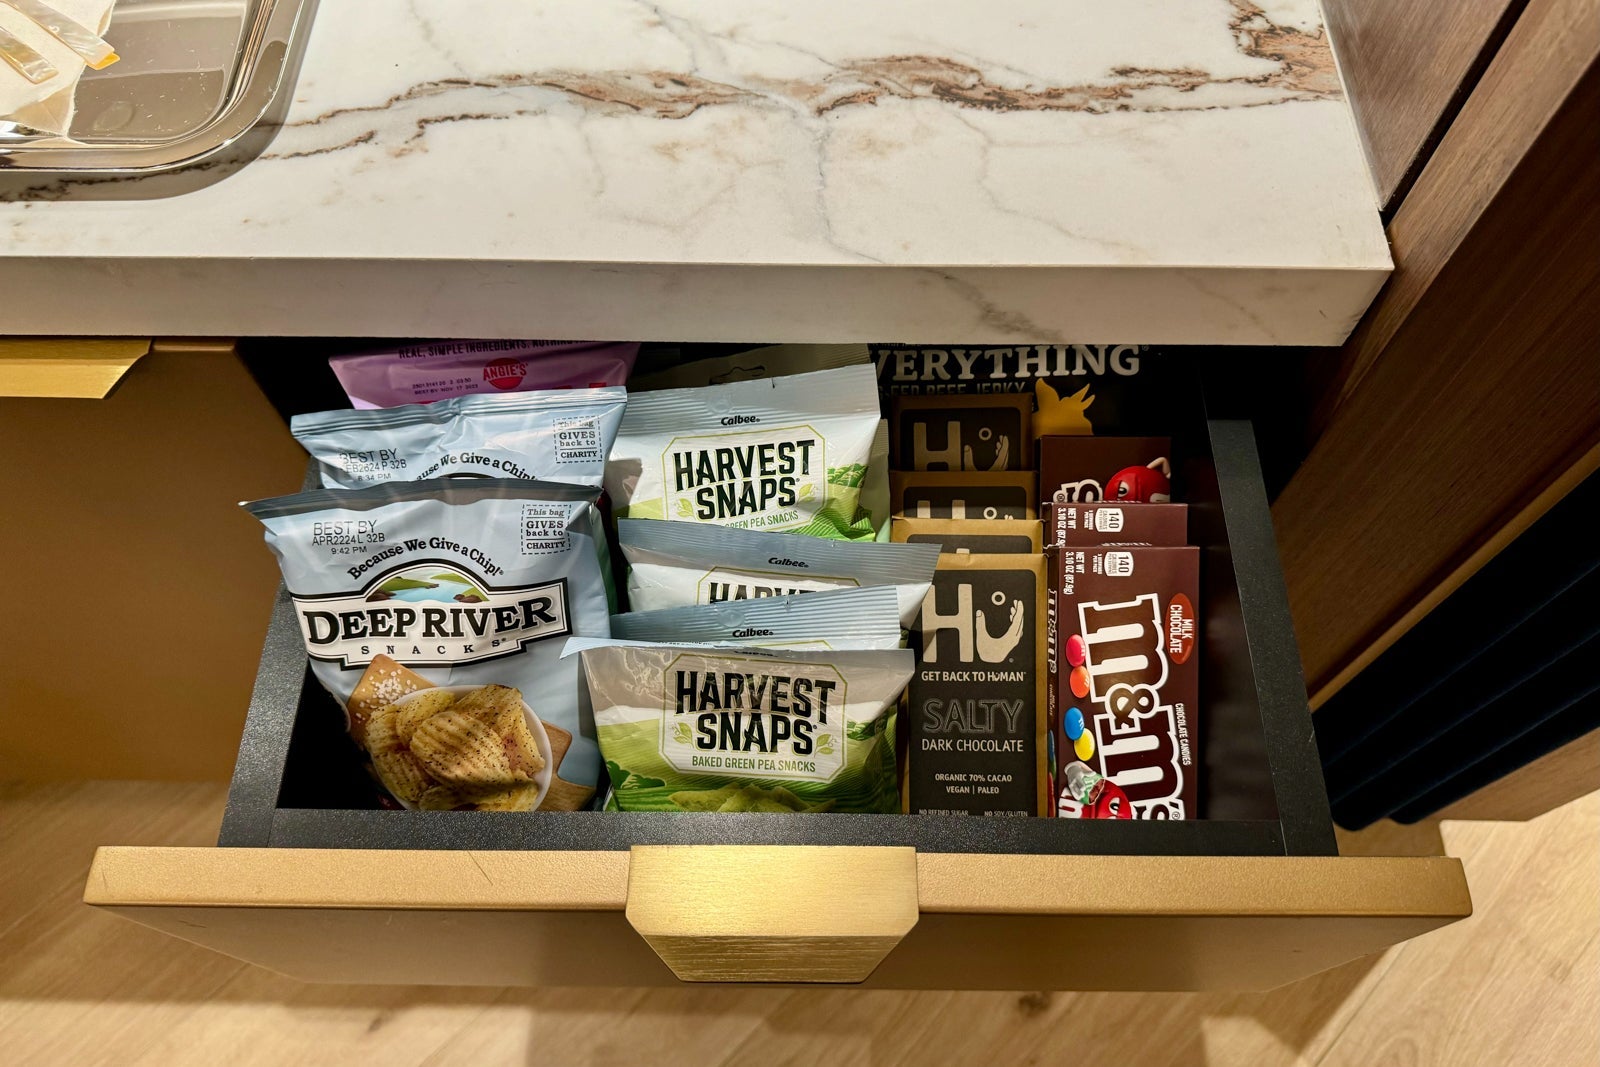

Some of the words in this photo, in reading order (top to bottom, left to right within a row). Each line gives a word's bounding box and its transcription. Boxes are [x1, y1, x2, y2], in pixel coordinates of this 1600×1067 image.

[429, 345, 465, 357] SIMPLE
[870, 344, 1140, 381] VERYTHING
[483, 363, 527, 381] ANGIE'S
[721, 415, 757, 426] Calbee
[559, 431, 596, 440] GIVES
[560, 439, 582, 447] back
[380, 448, 397, 461] BY
[440, 454, 458, 466] We
[460, 452, 491, 466] Give
[492, 459, 500, 468] a
[560, 450, 598, 459] CHARITY
[390, 459, 407, 469] 32B
[673, 439, 815, 493] HARVEST
[696, 476, 797, 520] SNAPS
[527, 508, 547, 516] This
[549, 508, 565, 517] bag
[1067, 507, 1077, 519] NET
[526, 520, 564, 529] GIVES
[750, 517, 766, 528] PEA
[767, 510, 799, 526] SNACKS
[1067, 520, 1077, 529] WT
[1108, 511, 1120, 529] 140
[313, 521, 353, 536] BEST
[358, 520, 377, 534] BY
[526, 529, 549, 537] back
[553, 529, 564, 537] to
[366, 532, 385, 543] 32B
[331, 547, 350, 555] 9:42
[526, 541, 566, 550] CHARITY
[347, 544, 404, 580] Because
[404, 538, 427, 552] We
[429, 537, 460, 553] Give
[461, 547, 468, 556] a
[469, 548, 501, 577] Chip!
[768, 557, 806, 568] Calbee
[1065, 551, 1075, 565] 3.10
[1075, 551, 1085, 563] NET
[1065, 565, 1075, 574] OZ
[1075, 564, 1085, 574] WT
[1117, 555, 1130, 573] 140
[303, 607, 417, 646] DEEP
[422, 596, 557, 638] RIVER
[732, 627, 770, 638] Calbee
[1170, 604, 1183, 654] CHOCOLATE
[1181, 618, 1193, 640] MILK
[361, 639, 502, 655] SNACKS
[921, 671, 941, 682] GET
[942, 671, 970, 682] BACK
[972, 671, 986, 682] TO
[987, 671, 1024, 682] HUMAN
[675, 669, 837, 725] HARVEST
[923, 697, 1025, 734] SALTY
[1174, 702, 1190, 738] CHOCOLATE
[696, 712, 814, 756] SNAPS
[922, 738, 953, 751] DARK
[956, 739, 1024, 752] CHOCOLATE
[1179, 737, 1192, 767] CANDIES
[692, 755, 722, 768] BAKED
[725, 757, 755, 770] GREEN
[757, 759, 776, 771] PEA
[778, 760, 816, 773] SNACKS
[935, 773, 967, 782] ORGANIC
[969, 774, 986, 782] 70%
[987, 774, 1013, 782] CACAO
[946, 785, 970, 794] VEGAN
[977, 786, 1000, 794] PALEO
[919, 808, 927, 816] NO
